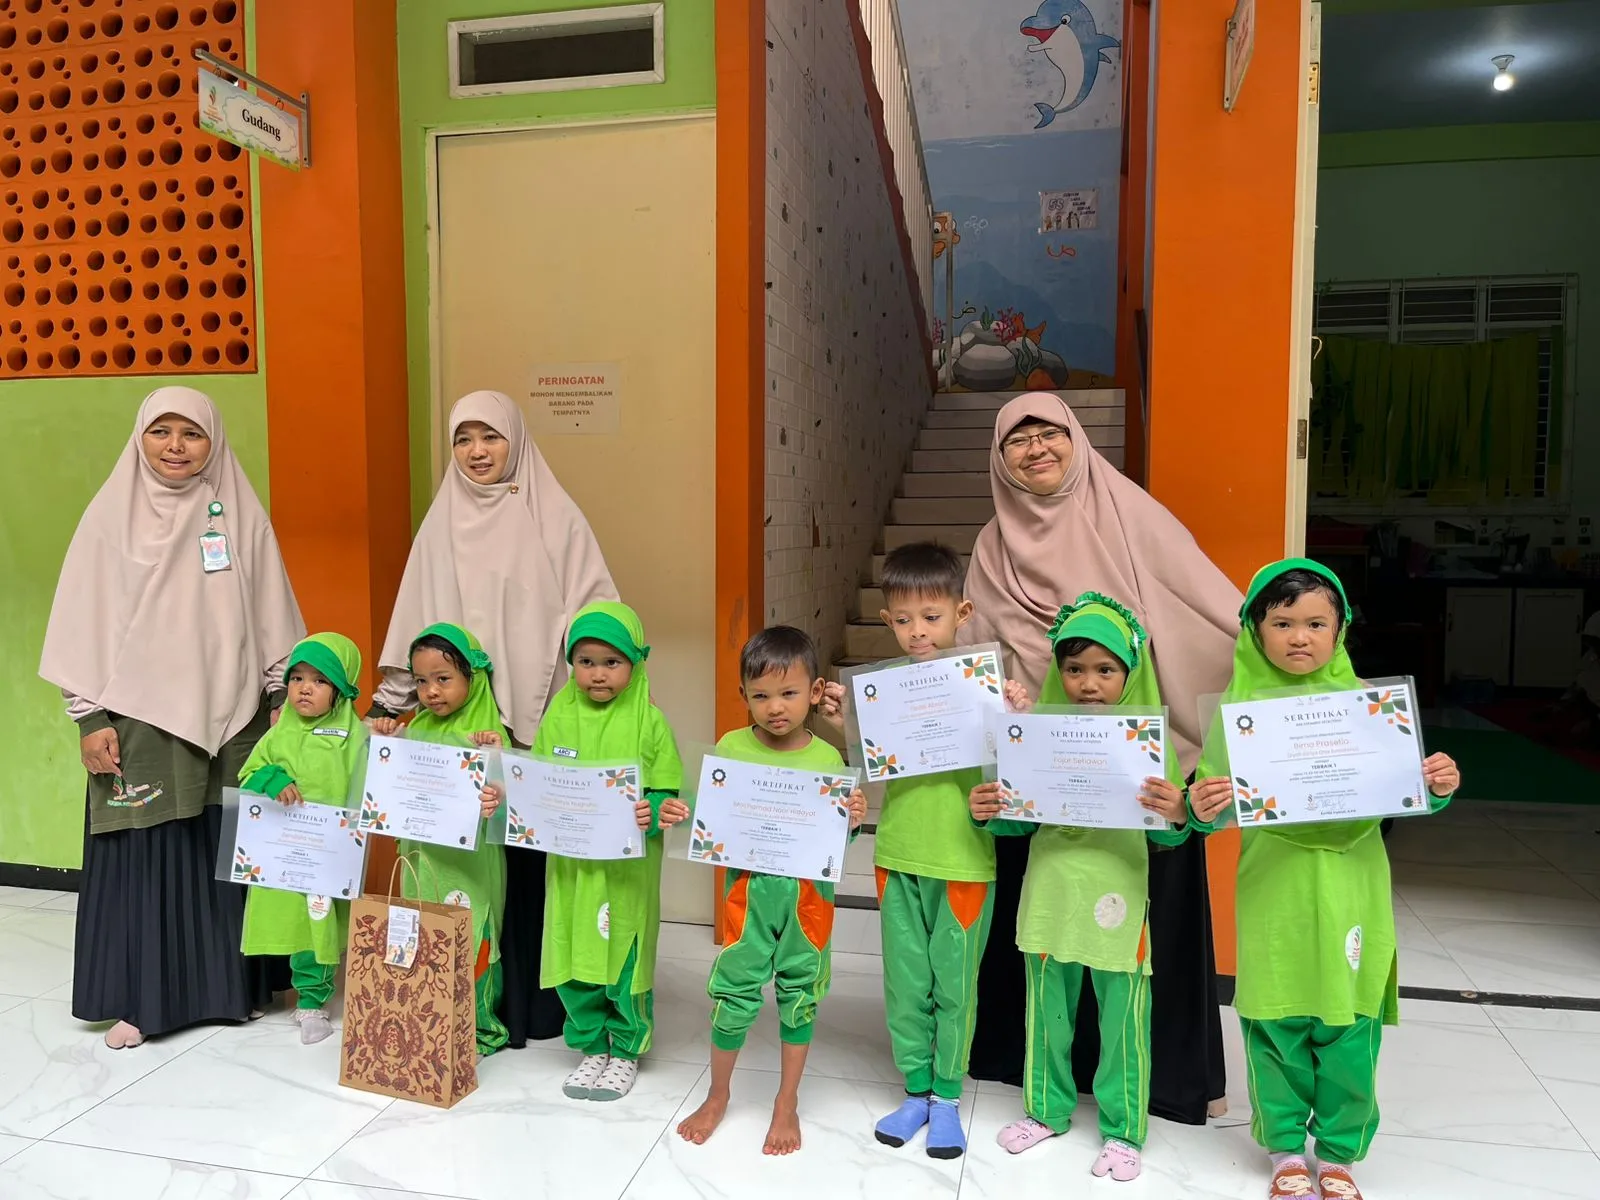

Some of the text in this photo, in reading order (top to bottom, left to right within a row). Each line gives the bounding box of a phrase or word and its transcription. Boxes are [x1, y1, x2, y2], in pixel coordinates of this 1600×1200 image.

[242, 108, 281, 141] Gudang
[1048, 198, 1065, 211] 5S
[538, 376, 605, 386] PERINGATAN
[899, 673, 950, 688] SERTIFIKAT
[1284, 709, 1349, 722] SERTIFIKAT
[1050, 731, 1110, 739] SERTIFIKAT
[410, 754, 449, 765] SERTIFIKAT
[1073, 756, 1108, 766] Setiawan
[543, 775, 592, 787] SERTIFIKAT
[752, 779, 805, 791] SERTIFIKAT
[284, 811, 328, 823] SERTIFIKAT
